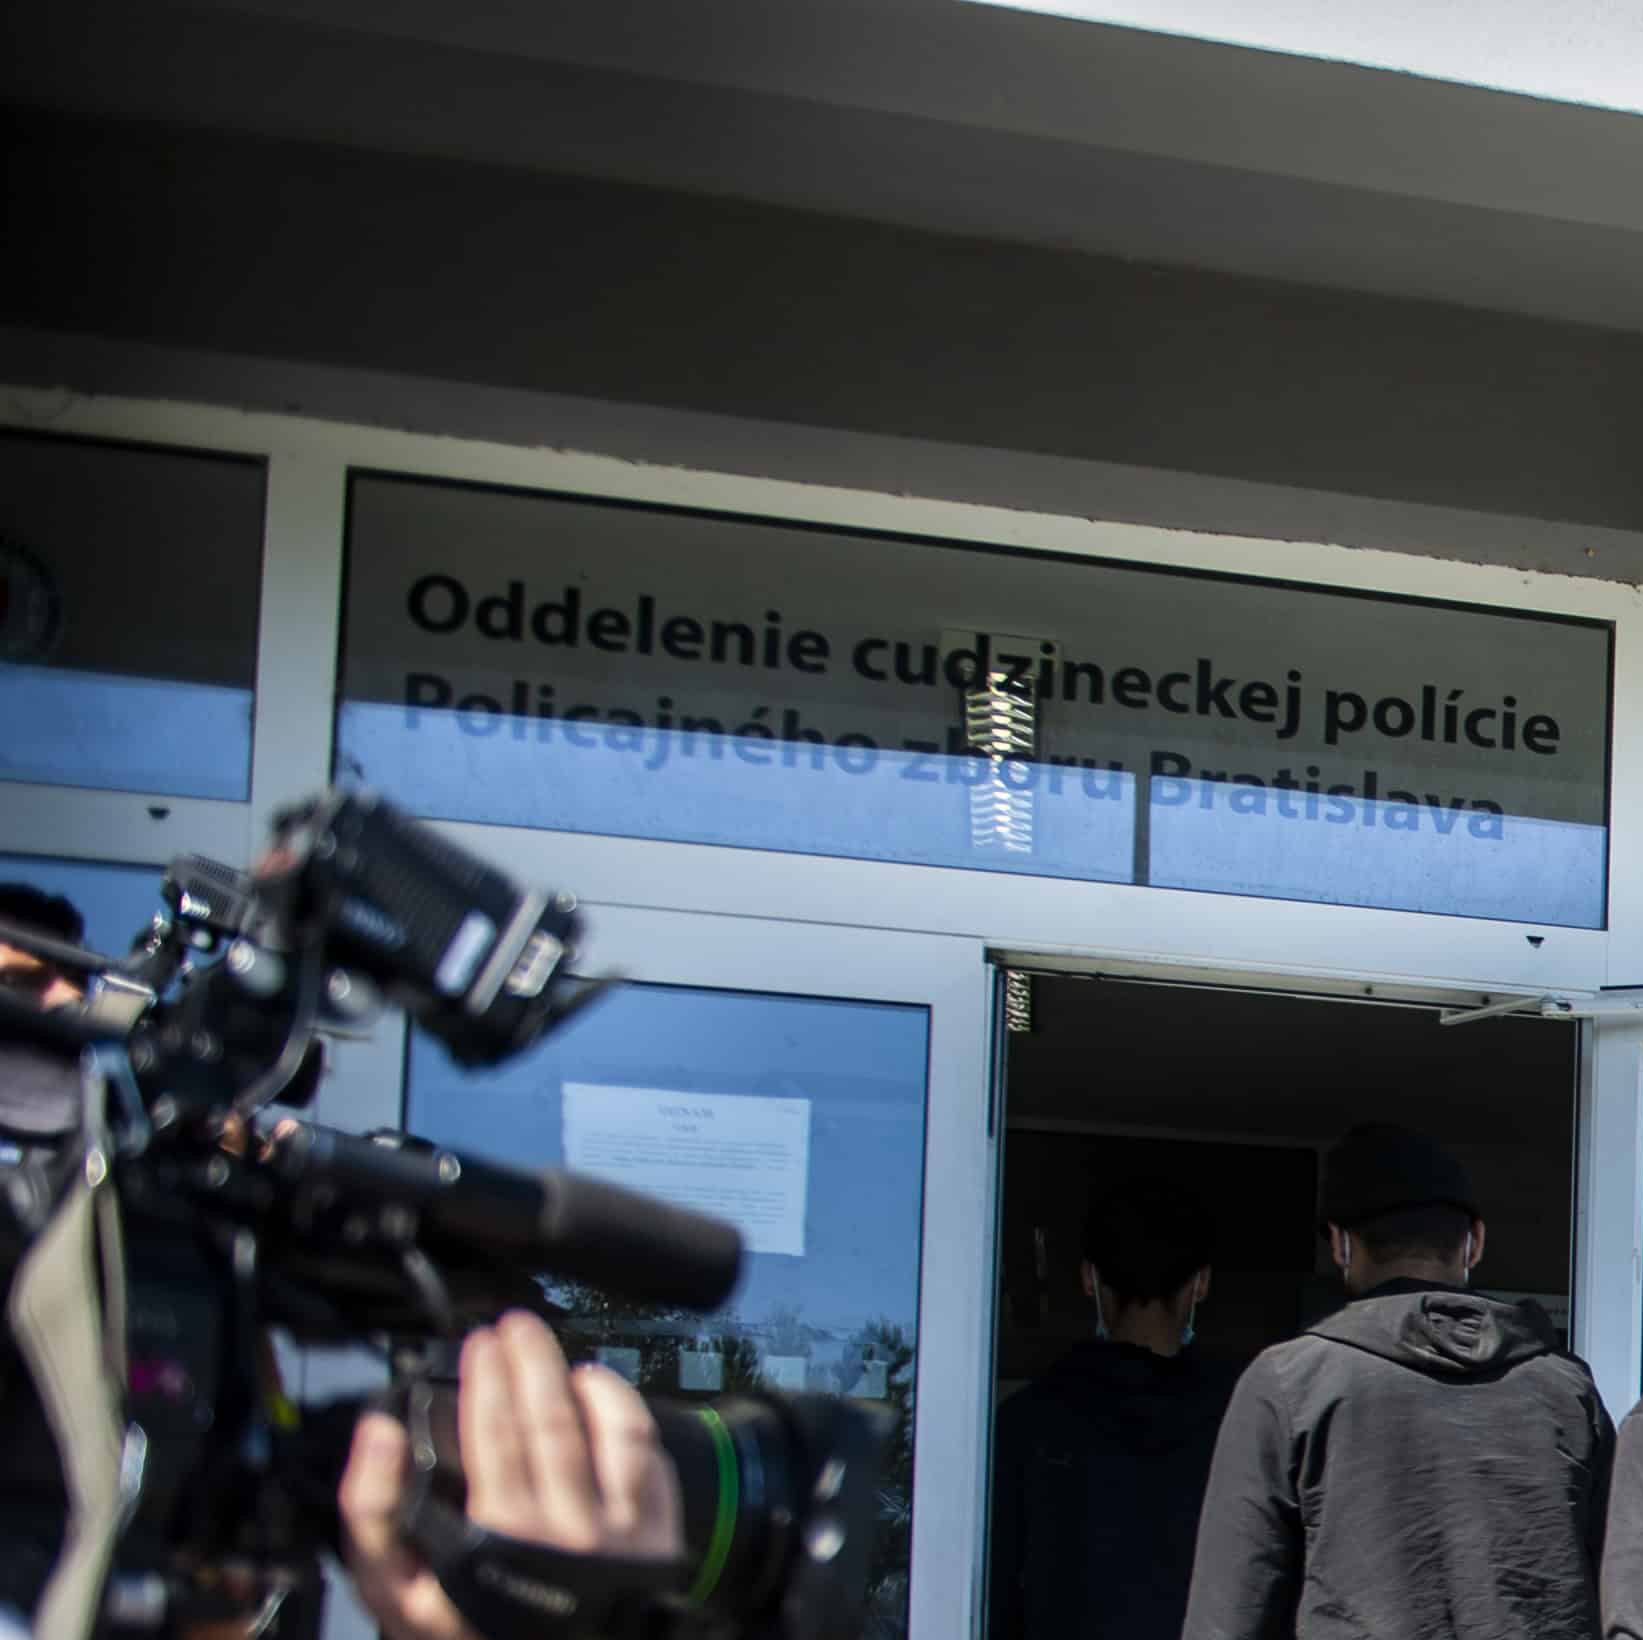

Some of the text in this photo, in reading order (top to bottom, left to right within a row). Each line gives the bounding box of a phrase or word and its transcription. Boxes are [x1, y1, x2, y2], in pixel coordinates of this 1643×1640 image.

[407, 574, 1560, 755] Oddelenie cudzineckej polície
[404, 673, 1505, 841] Policajného zboru Bratislava
